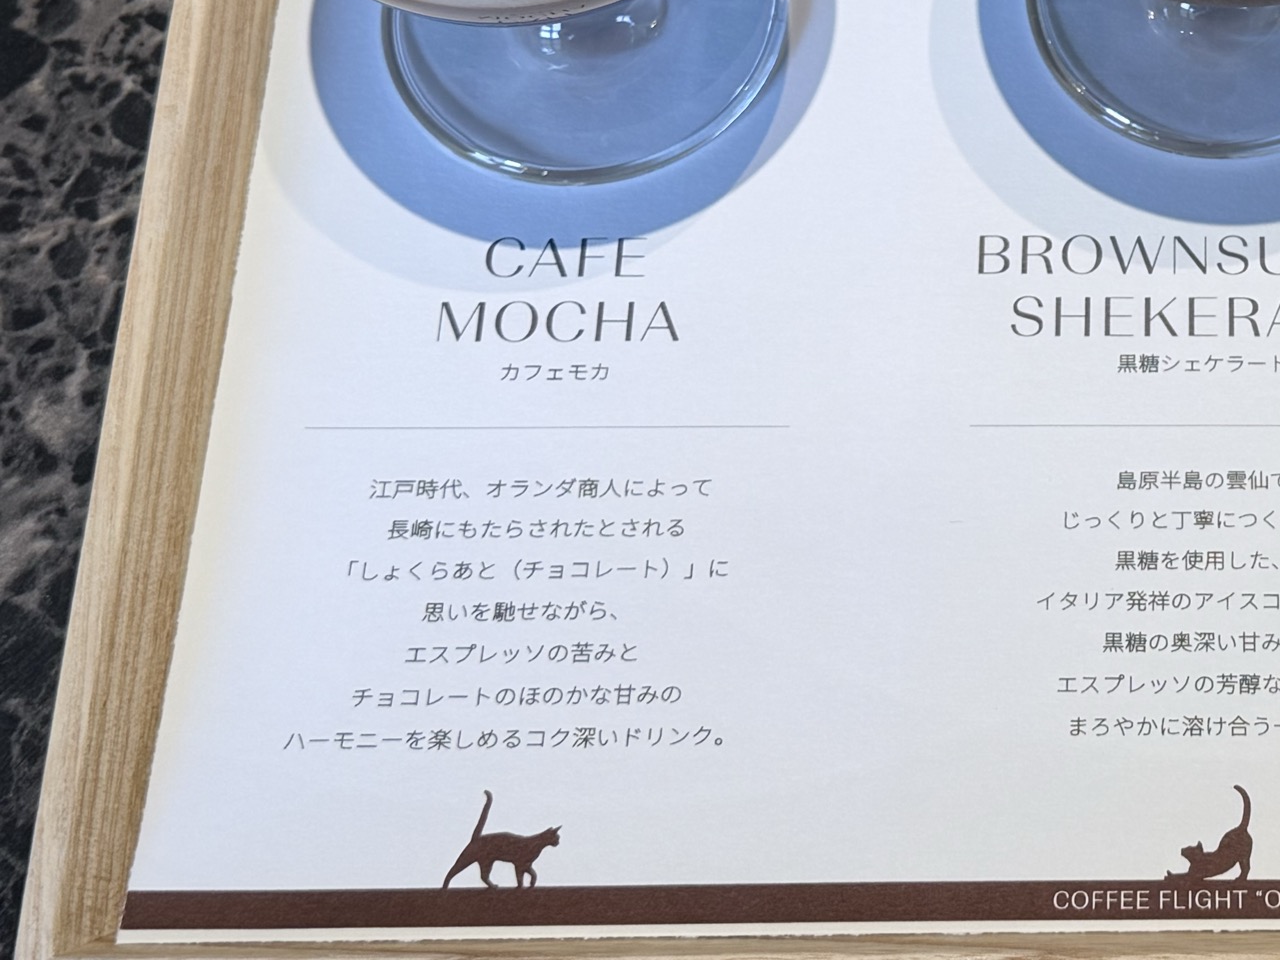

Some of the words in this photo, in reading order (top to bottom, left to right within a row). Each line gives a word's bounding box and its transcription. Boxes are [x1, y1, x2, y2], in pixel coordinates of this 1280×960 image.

[484, 236, 646, 279] CAFE
[436, 300, 680, 344] MOCHA
[500, 362, 610, 382] カフェモカ
[368, 477, 713, 500] 江戸時代、オランダ商人によって
[387, 517, 685, 541] 長崎にもたらされたとされる
[347, 557, 729, 582] 「しょくらあと（チョコレート）」に
[1114, 549, 1279, 572] 黒糖を使用した、
[421, 599, 618, 623] 思いを馳せながら、
[404, 641, 638, 665] エスプレッソの苦みと
[351, 683, 682, 708] チョコレートのほのかな甘みの
[282, 725, 724, 751] ハーモニーを楽しめるコク深いドリンク。
[1053, 890, 1150, 910] COFFEE
[1159, 889, 1248, 910] FLIGHT
